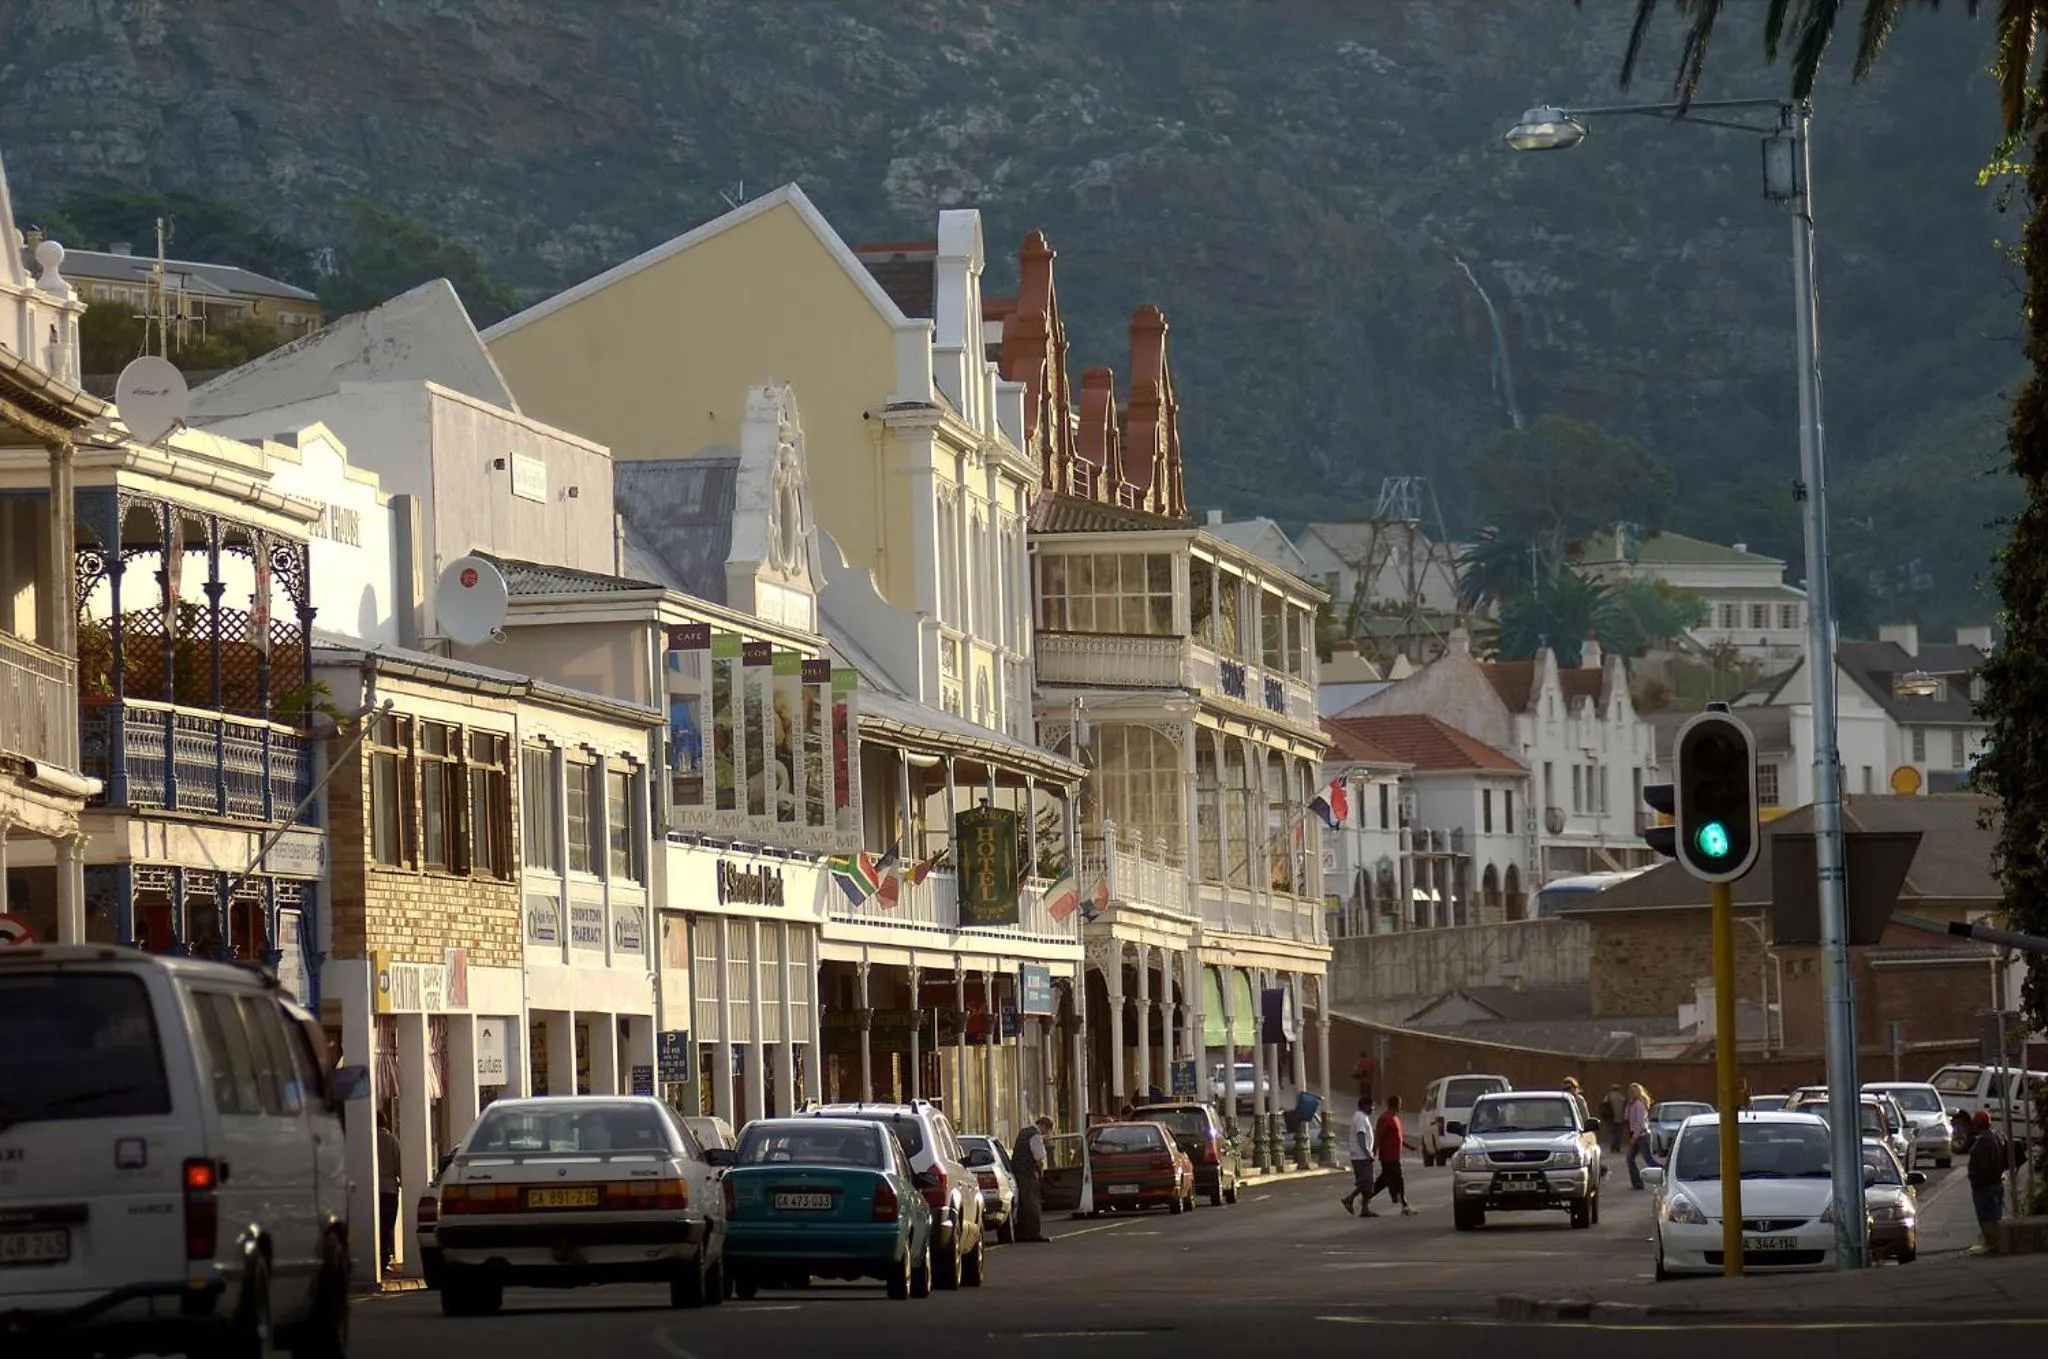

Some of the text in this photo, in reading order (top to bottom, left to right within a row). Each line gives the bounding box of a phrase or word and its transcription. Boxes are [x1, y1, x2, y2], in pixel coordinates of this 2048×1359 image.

[704, 728, 713, 779] meeting
[680, 810, 712, 824] TMP
[976, 827, 997, 901] HOTEL
[667, 1033, 676, 1046] P
[530, 1191, 543, 1205] CA
